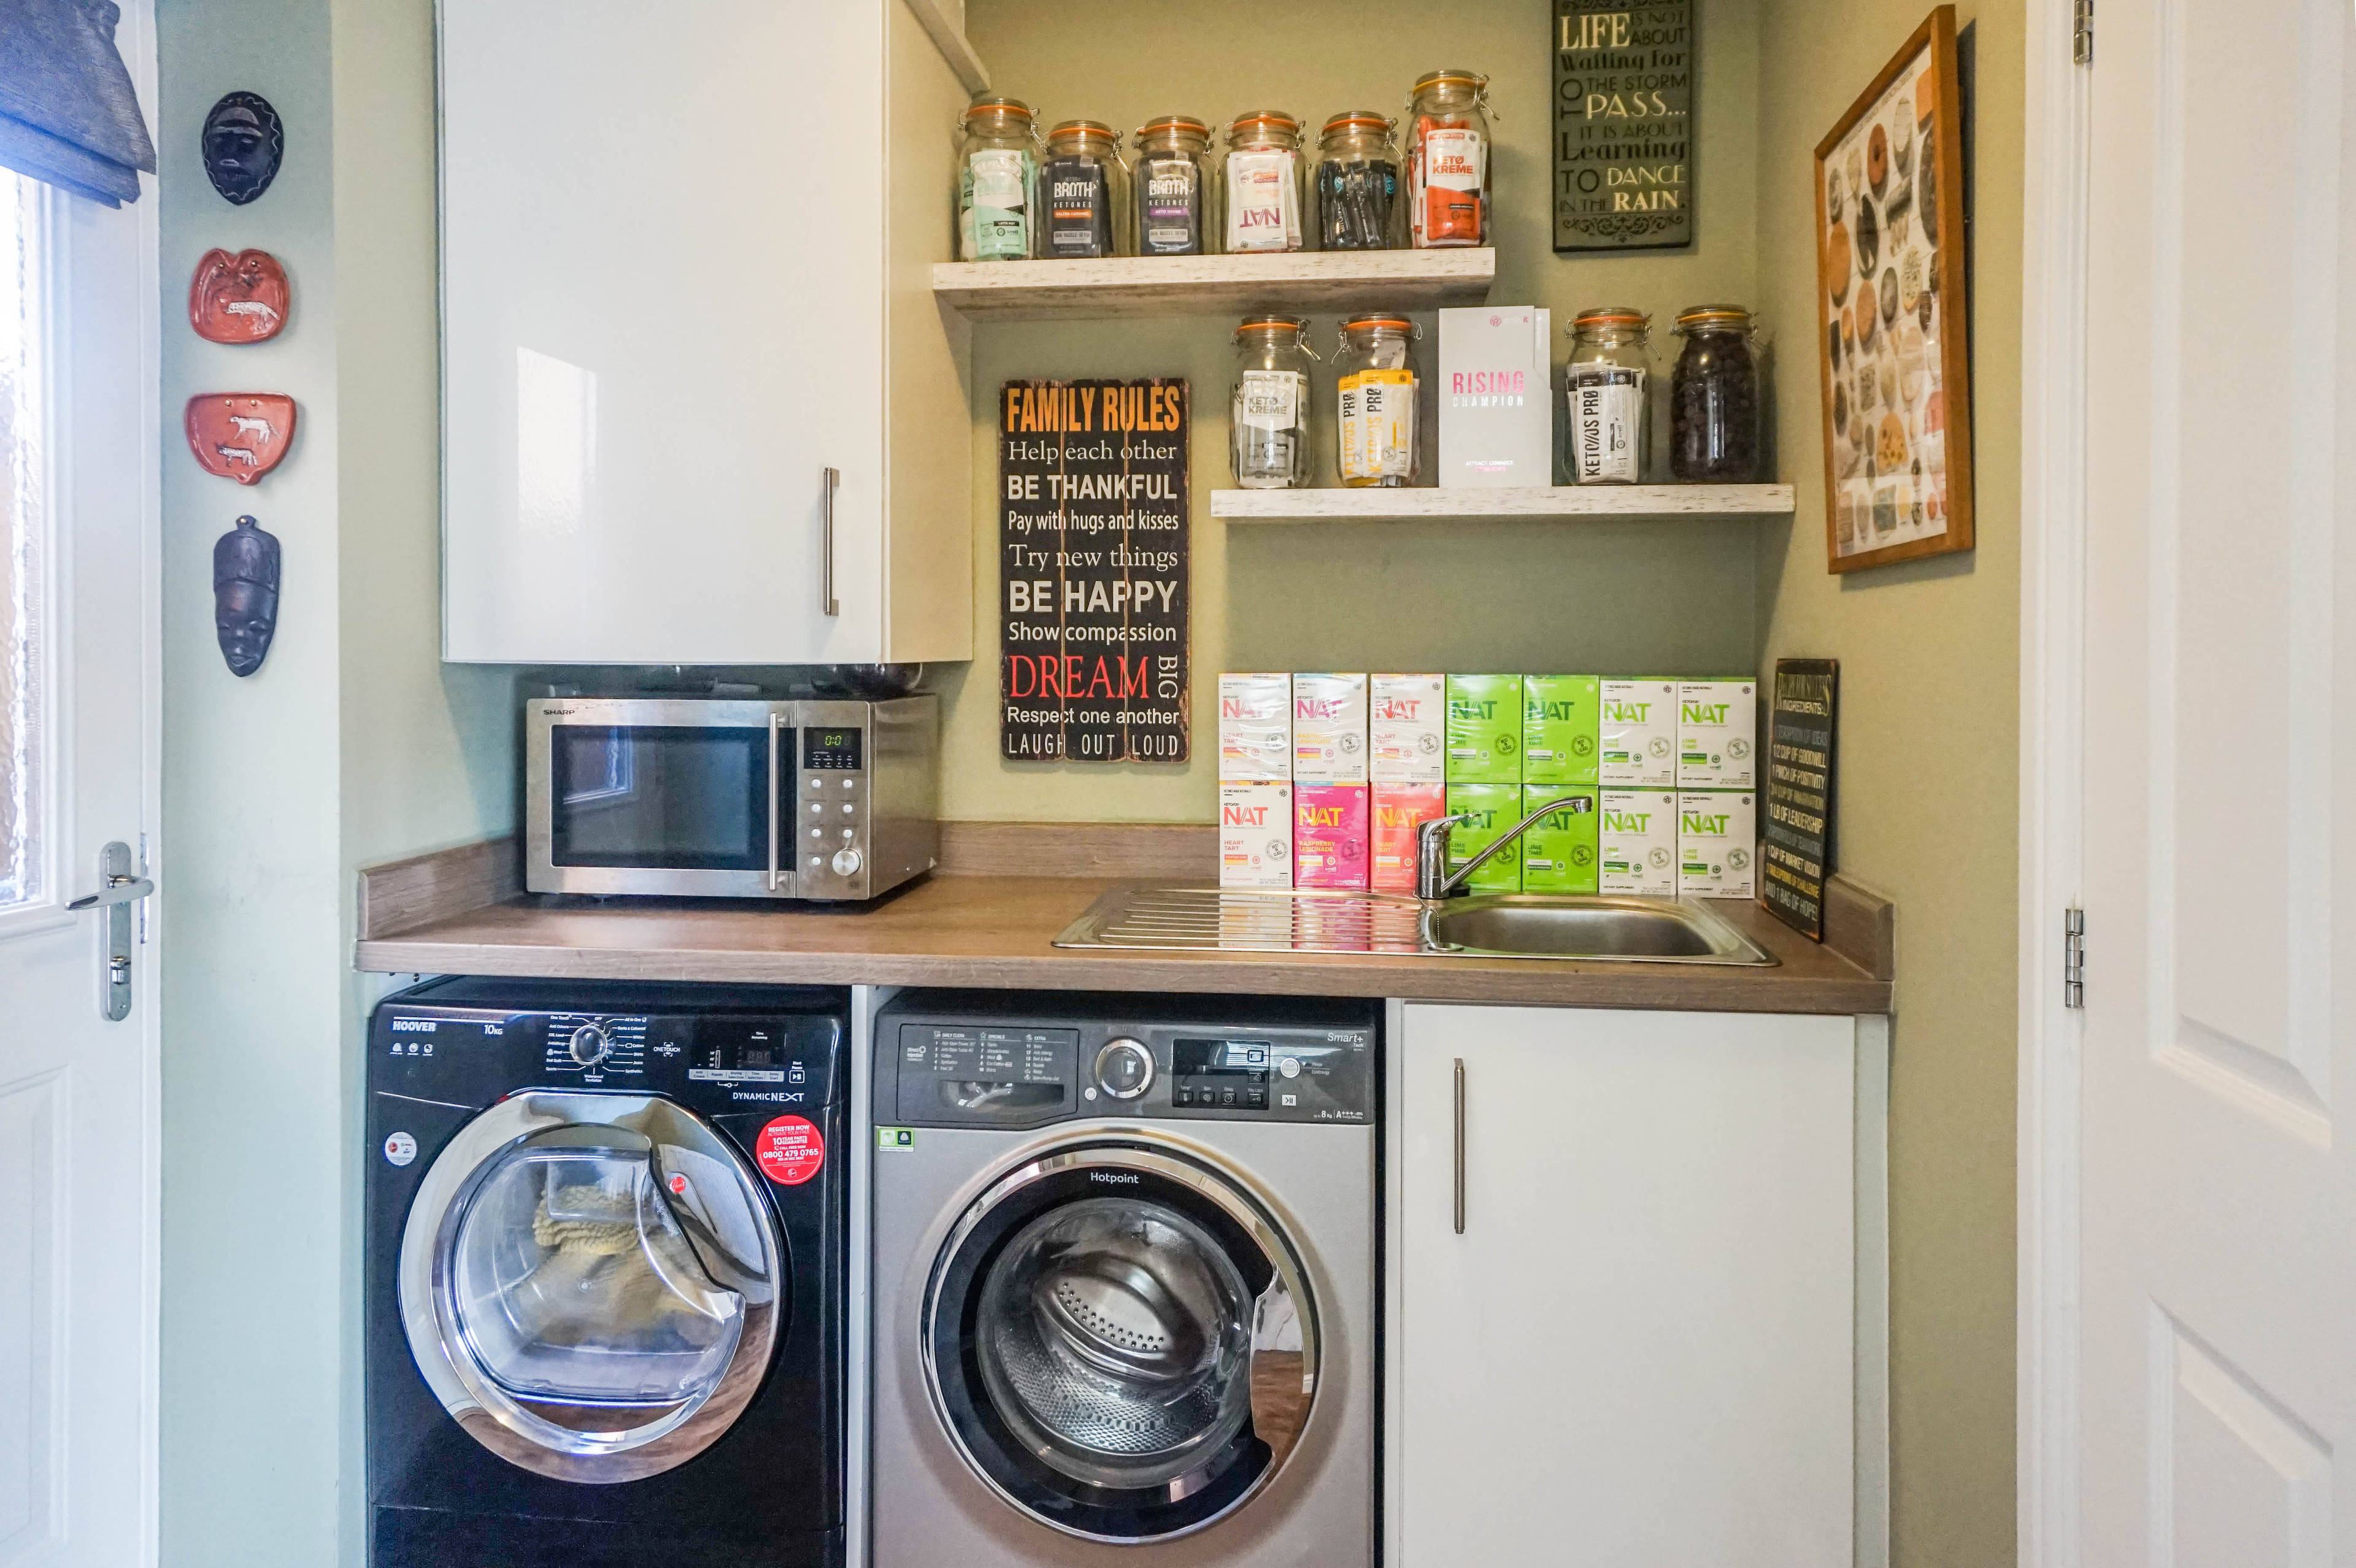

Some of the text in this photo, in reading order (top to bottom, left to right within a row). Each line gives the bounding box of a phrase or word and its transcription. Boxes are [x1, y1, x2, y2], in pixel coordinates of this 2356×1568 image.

[1560, 13, 1630, 49] LIFE
[1630, 27, 1685, 45] ABOUT
[1560, 53, 1644, 72] Waiting
[1587, 73, 1687, 91] THE STORM
[1622, 123, 1684, 139] ABOUT
[1561, 131, 1687, 162] Learning
[1433, 165, 1473, 174] KREME
[1560, 165, 1685, 194] TO DANCE
[1054, 182, 1092, 198] BROTH
[1453, 371, 1524, 394] RISING
[1007, 385, 1180, 432] FAMILY RULES
[1248, 405, 1287, 415] KREME
[1452, 396, 1523, 407] CHAMPION
[1008, 439, 1177, 465] Help each other
[1007, 474, 1177, 499] BE THANKFUL
[1008, 509, 1179, 536] Pay with hugs and kisses
[1008, 542, 1178, 572] Try new things
[1009, 580, 1178, 613] BE HAPPY
[1009, 621, 1177, 645] Show compassion
[1009, 655, 1178, 699] DREAM BIG
[1007, 706, 1179, 726] Respect one another
[1297, 699, 1342, 719] NAT
[1376, 700, 1420, 719] NAT
[1452, 701, 1498, 720] NAT
[1528, 701, 1574, 721] NAT
[1604, 703, 1651, 722] NAT
[1682, 704, 1730, 723] NAT
[1008, 733, 1178, 756] LAUGH OUT LOUD
[1224, 807, 1268, 825] NAT
[1299, 807, 1344, 826] NAT
[1376, 808, 1421, 828] NAT
[1604, 813, 1652, 832] NAT
[1682, 815, 1730, 834] NAT
[1780, 805, 1788, 821] OF
[1788, 808, 1823, 834] LEADERSHIP
[1792, 894, 1800, 910] OF
[393, 1021, 436, 1031] HOOVER
[772, 1137, 782, 1145] 10
[1090, 1172, 1139, 1184] Hotpoint
